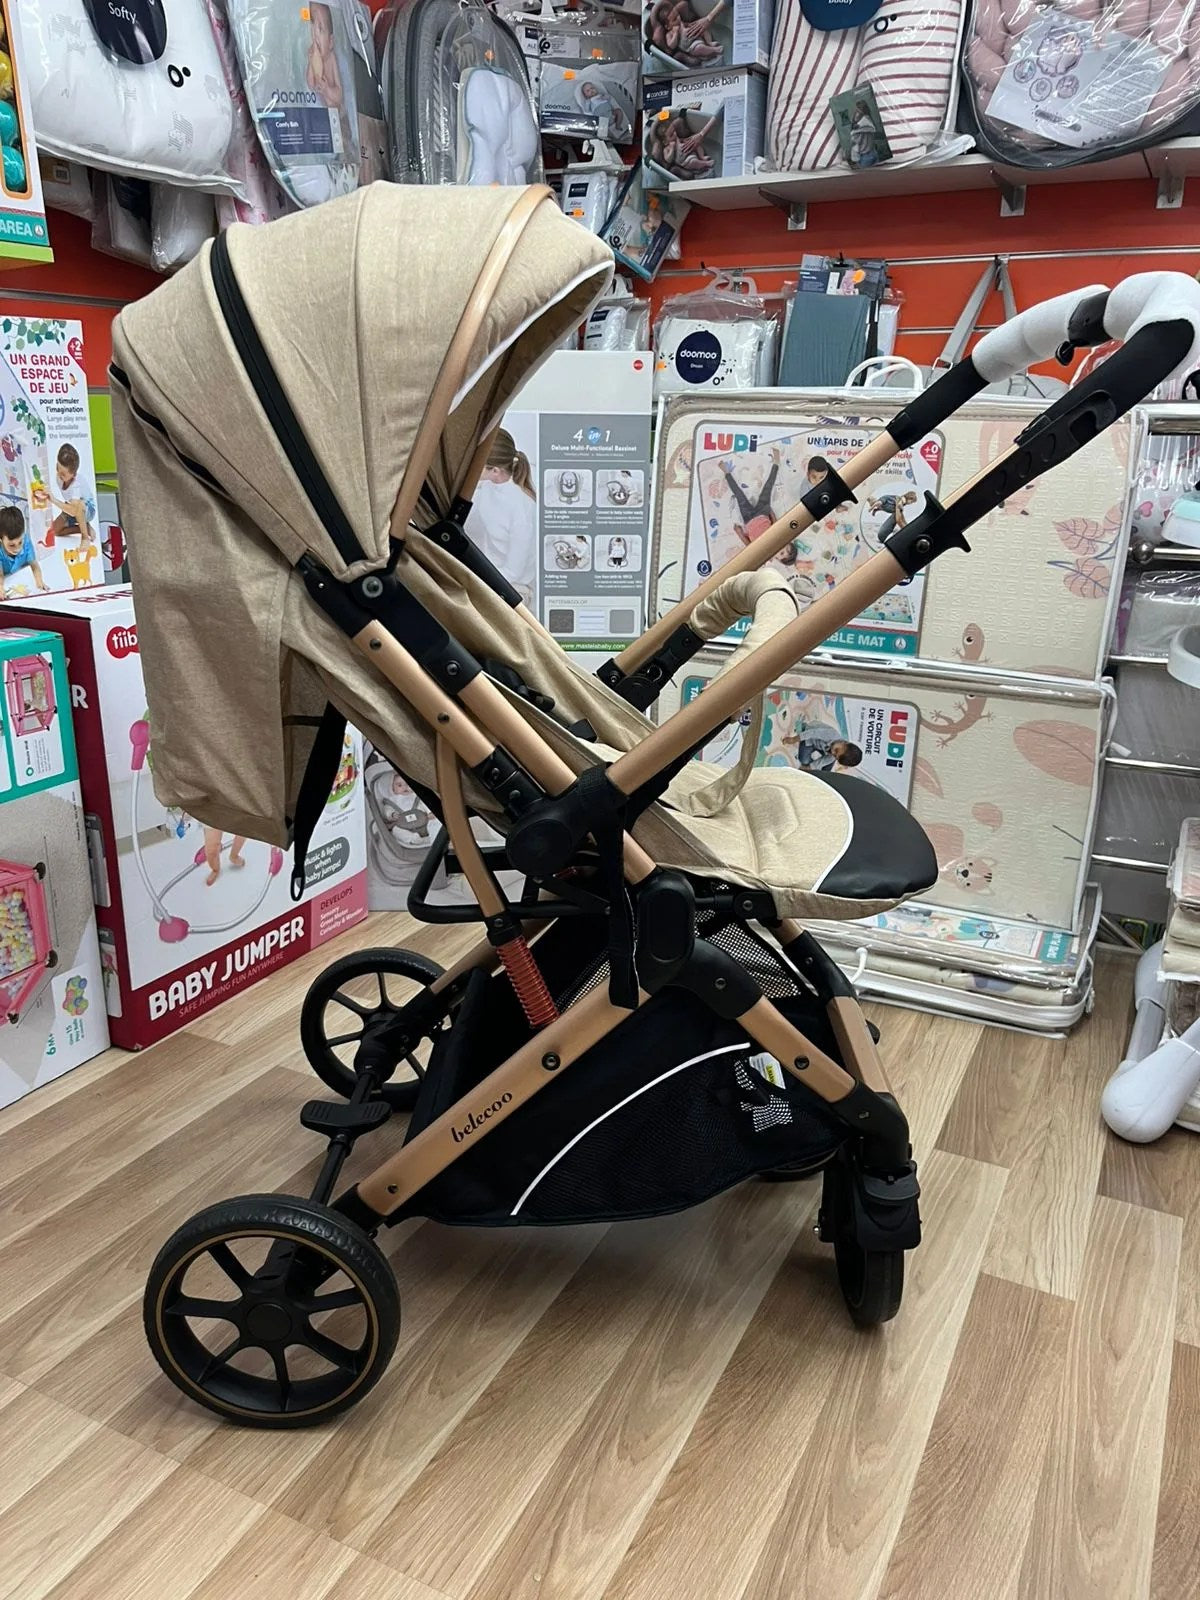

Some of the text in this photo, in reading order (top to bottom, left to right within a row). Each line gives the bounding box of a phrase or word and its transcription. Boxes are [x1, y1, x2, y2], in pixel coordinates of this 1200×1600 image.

[108, 2, 136, 24] Softy
[676, 75, 740, 93] Coussin de bain
[0, 219, 33, 237] AREA
[10, 354, 27, 365] UN
[31, 355, 70, 366] GRAND
[681, 349, 717, 359] doomoo
[22, 368, 64, 380] ESPACE
[30, 383, 69, 394] DE JEU
[573, 428, 584, 442] 4
[606, 430, 611, 443] 1
[808, 437, 864, 448] UN TAPIS DE
[827, 632, 886, 648] BLE MAT
[865, 708, 876, 755] DE VOITURE
[874, 709, 884, 755] UN CIRCUIT
[326, 843, 343, 856] lights
[315, 857, 332, 870] when
[306, 872, 322, 884] baby
[321, 886, 353, 910] DEVELOPS
[149, 916, 305, 1021] BABY JUMPER
[180, 951, 285, 1018] SAFE JUMPING FUN ANYWHERE
[451, 1092, 513, 1143] belecoo
